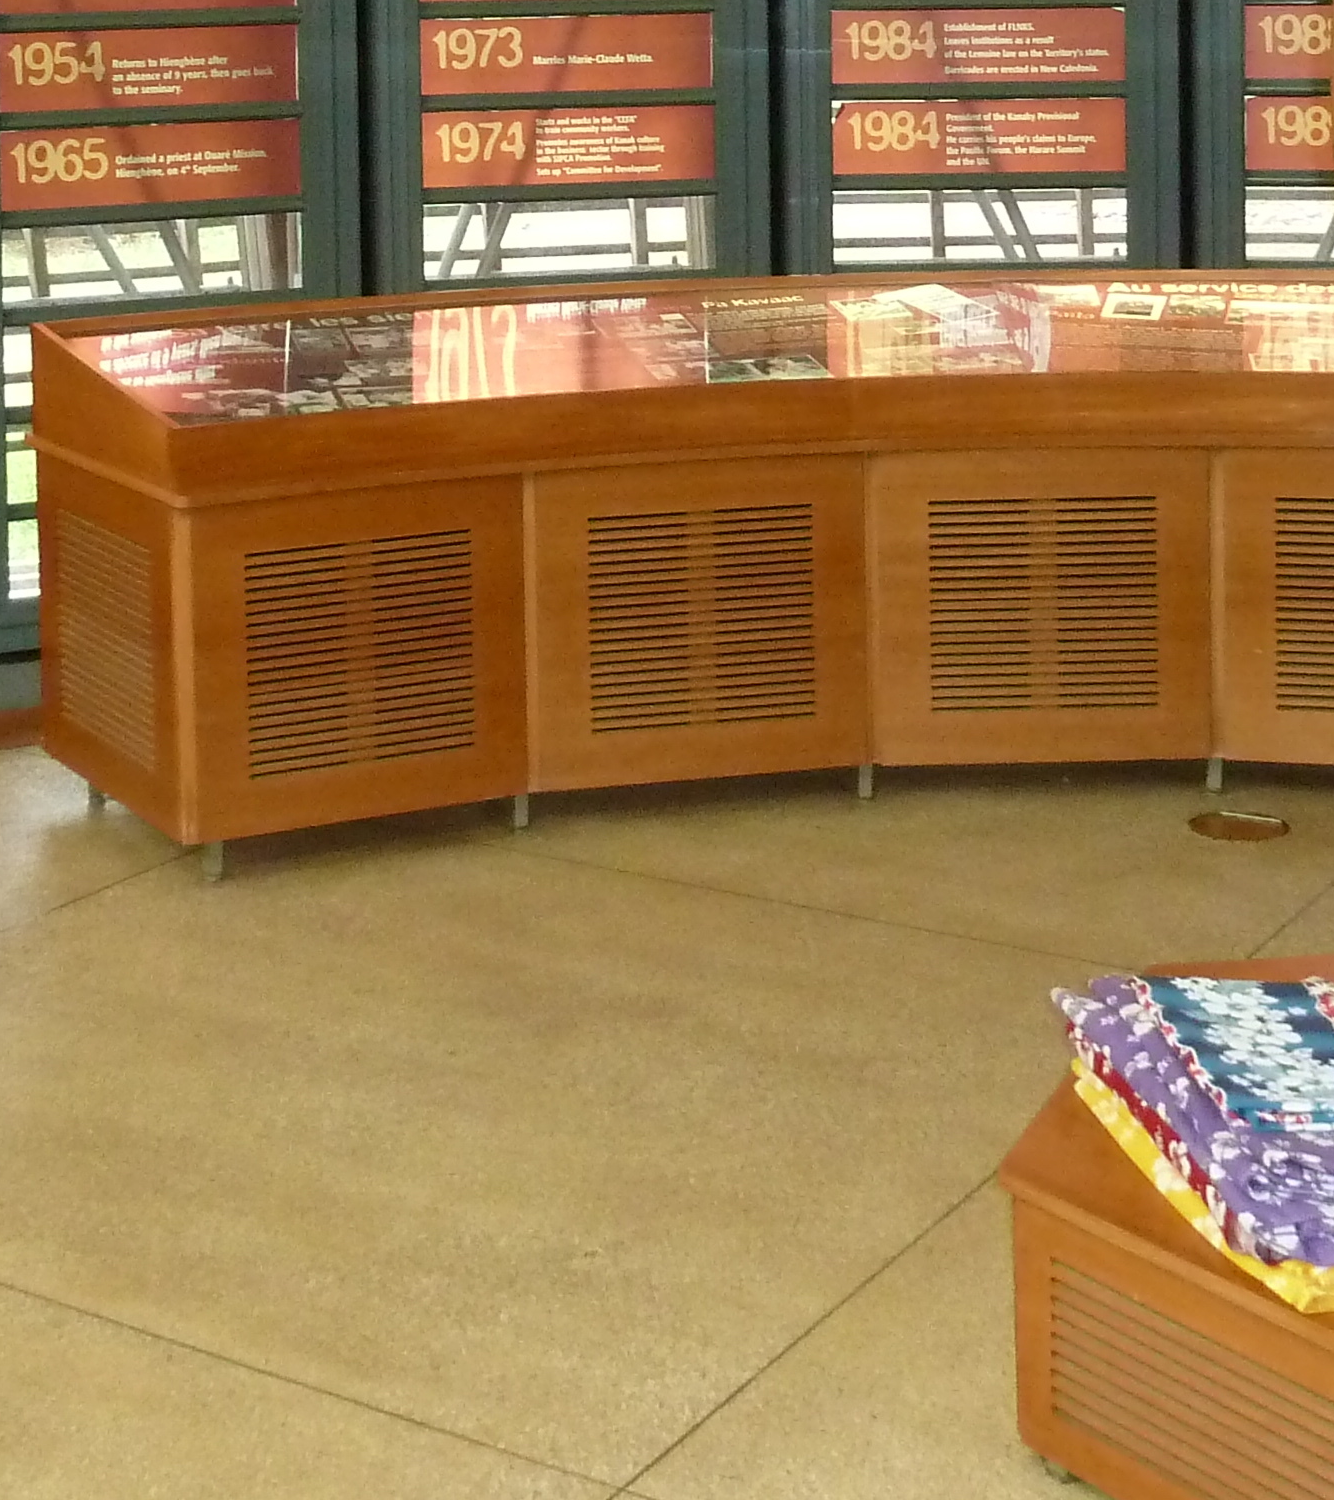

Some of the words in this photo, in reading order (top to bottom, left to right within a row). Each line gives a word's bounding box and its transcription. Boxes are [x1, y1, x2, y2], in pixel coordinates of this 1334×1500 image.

[432, 26, 523, 69] 1973
[845, 20, 937, 61] 1984
[1258, 14, 1332, 55] 198
[8, 41, 105, 86] 1954
[435, 121, 526, 163] 1974
[848, 110, 940, 151] 1984
[1261, 105, 1332, 147] 198
[10, 138, 108, 184] 1965
